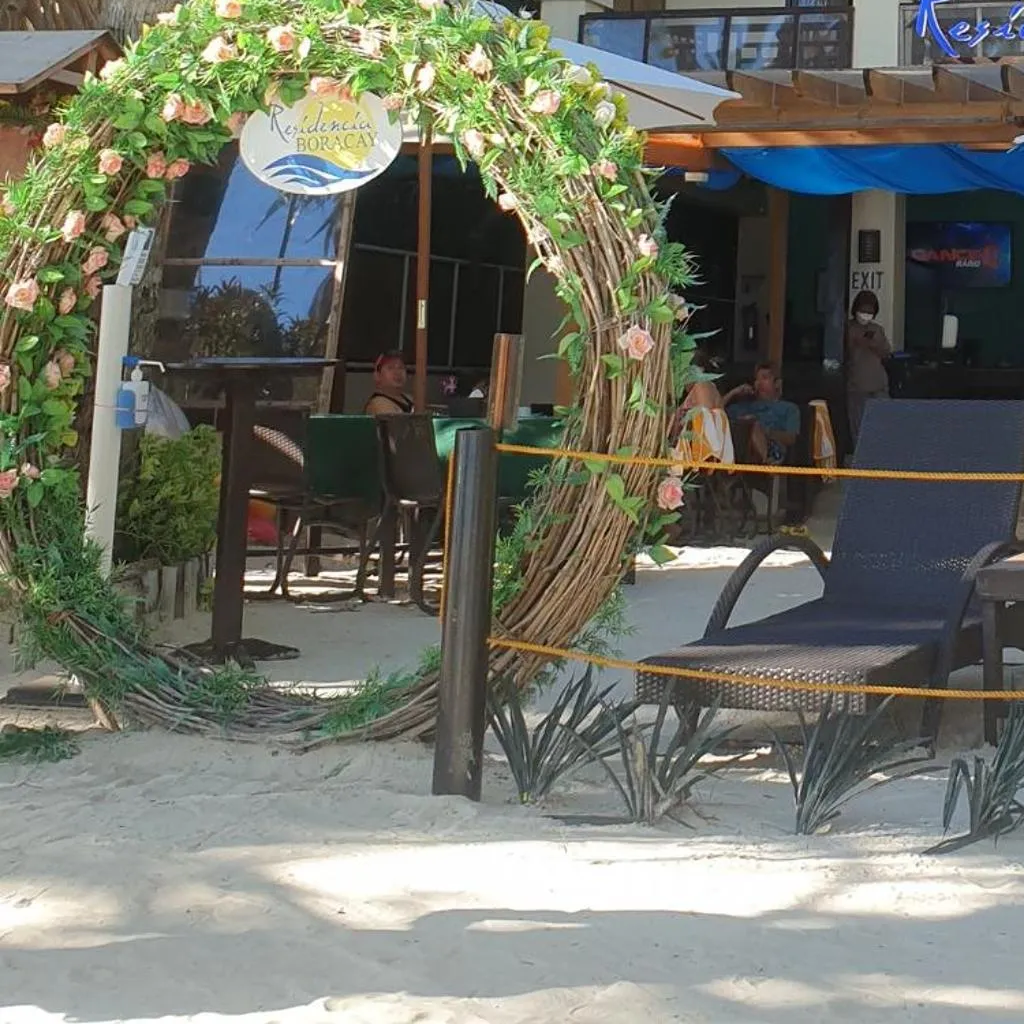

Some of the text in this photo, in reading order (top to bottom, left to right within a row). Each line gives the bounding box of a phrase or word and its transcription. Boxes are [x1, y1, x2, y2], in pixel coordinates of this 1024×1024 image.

[269, 102, 373, 144] Residencia
[296, 132, 377, 152] BORACAY
[852, 272, 884, 289] EXIT
